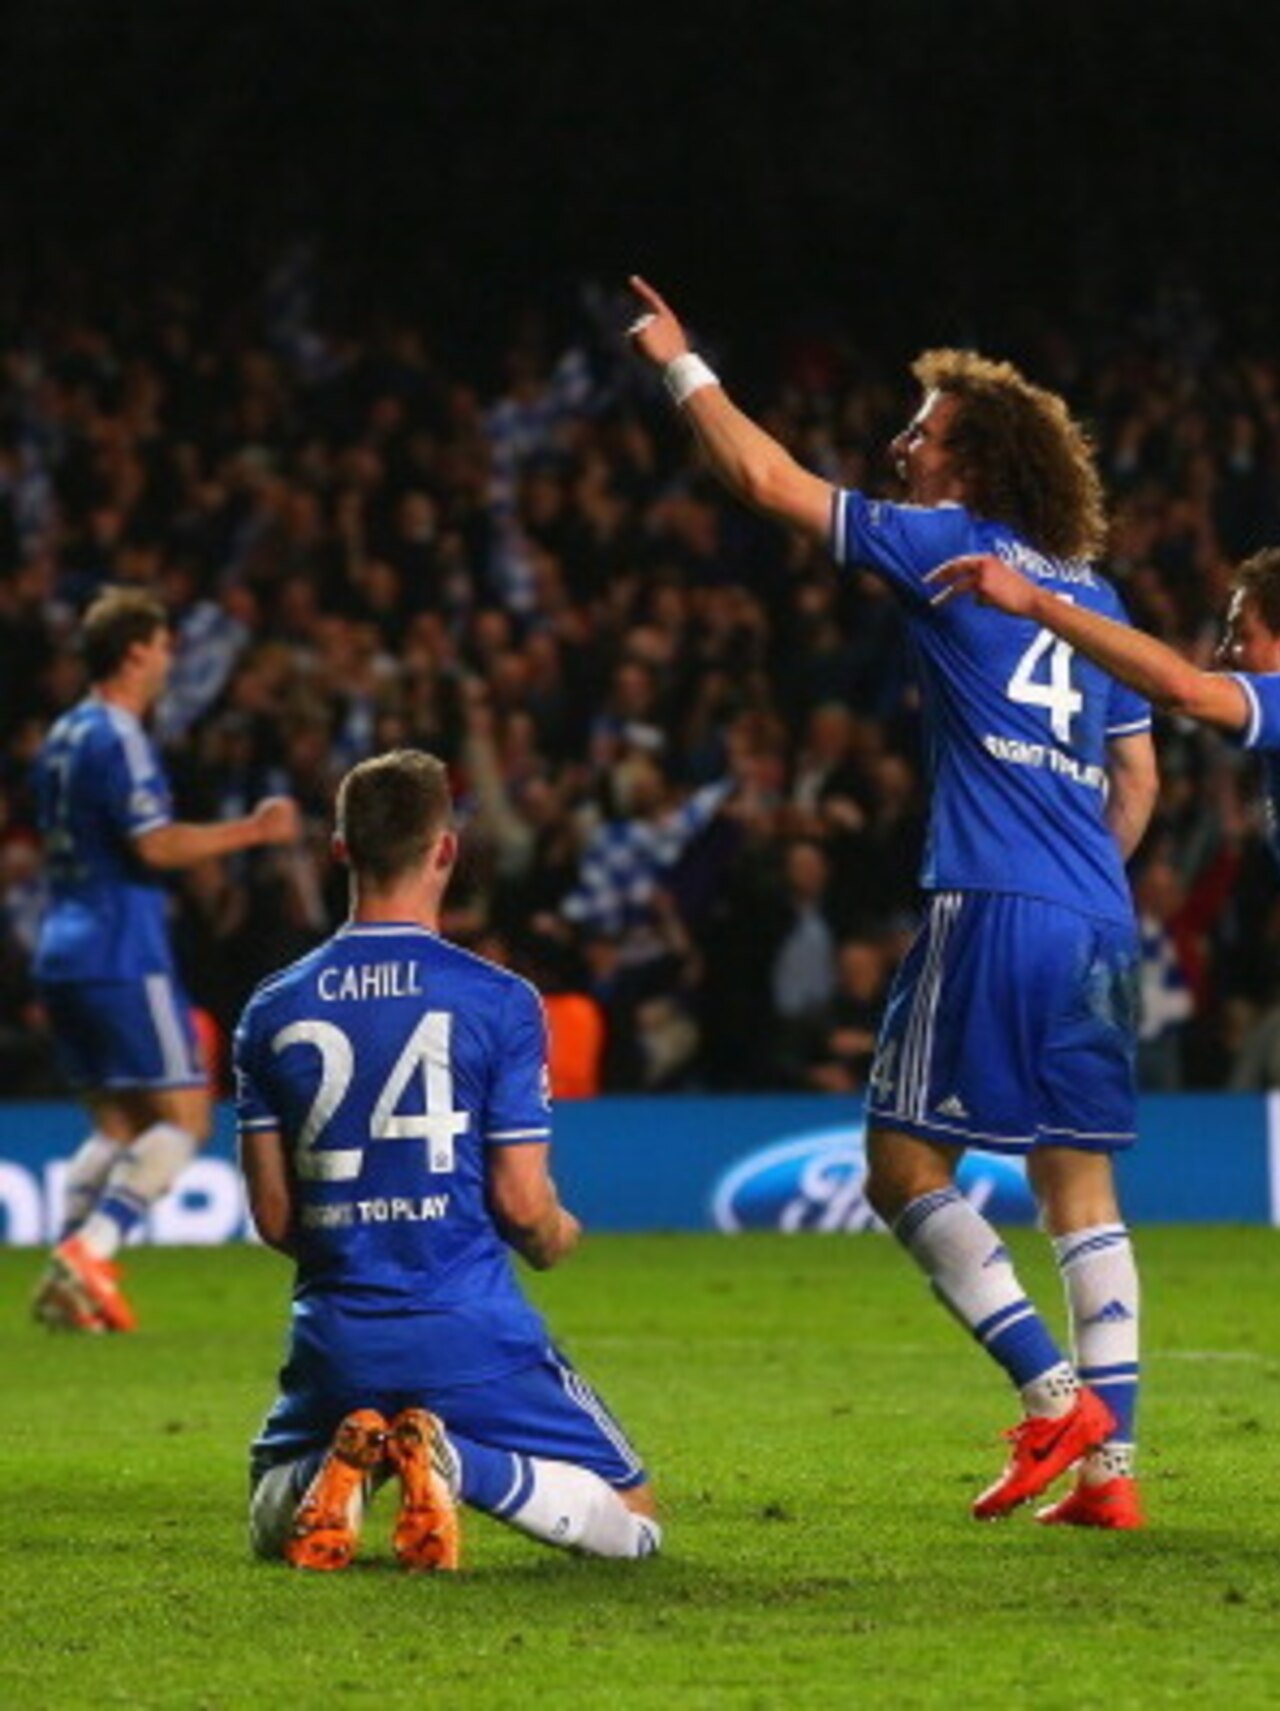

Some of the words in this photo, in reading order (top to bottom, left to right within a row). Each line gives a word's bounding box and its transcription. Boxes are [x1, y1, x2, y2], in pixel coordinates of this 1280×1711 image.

[1007, 594, 1083, 743] 4
[317, 960, 422, 1001] CAHILL
[270, 1010, 471, 1182] 24
[356, 1198, 389, 1224] TO
[390, 1194, 450, 1221] PLAY
